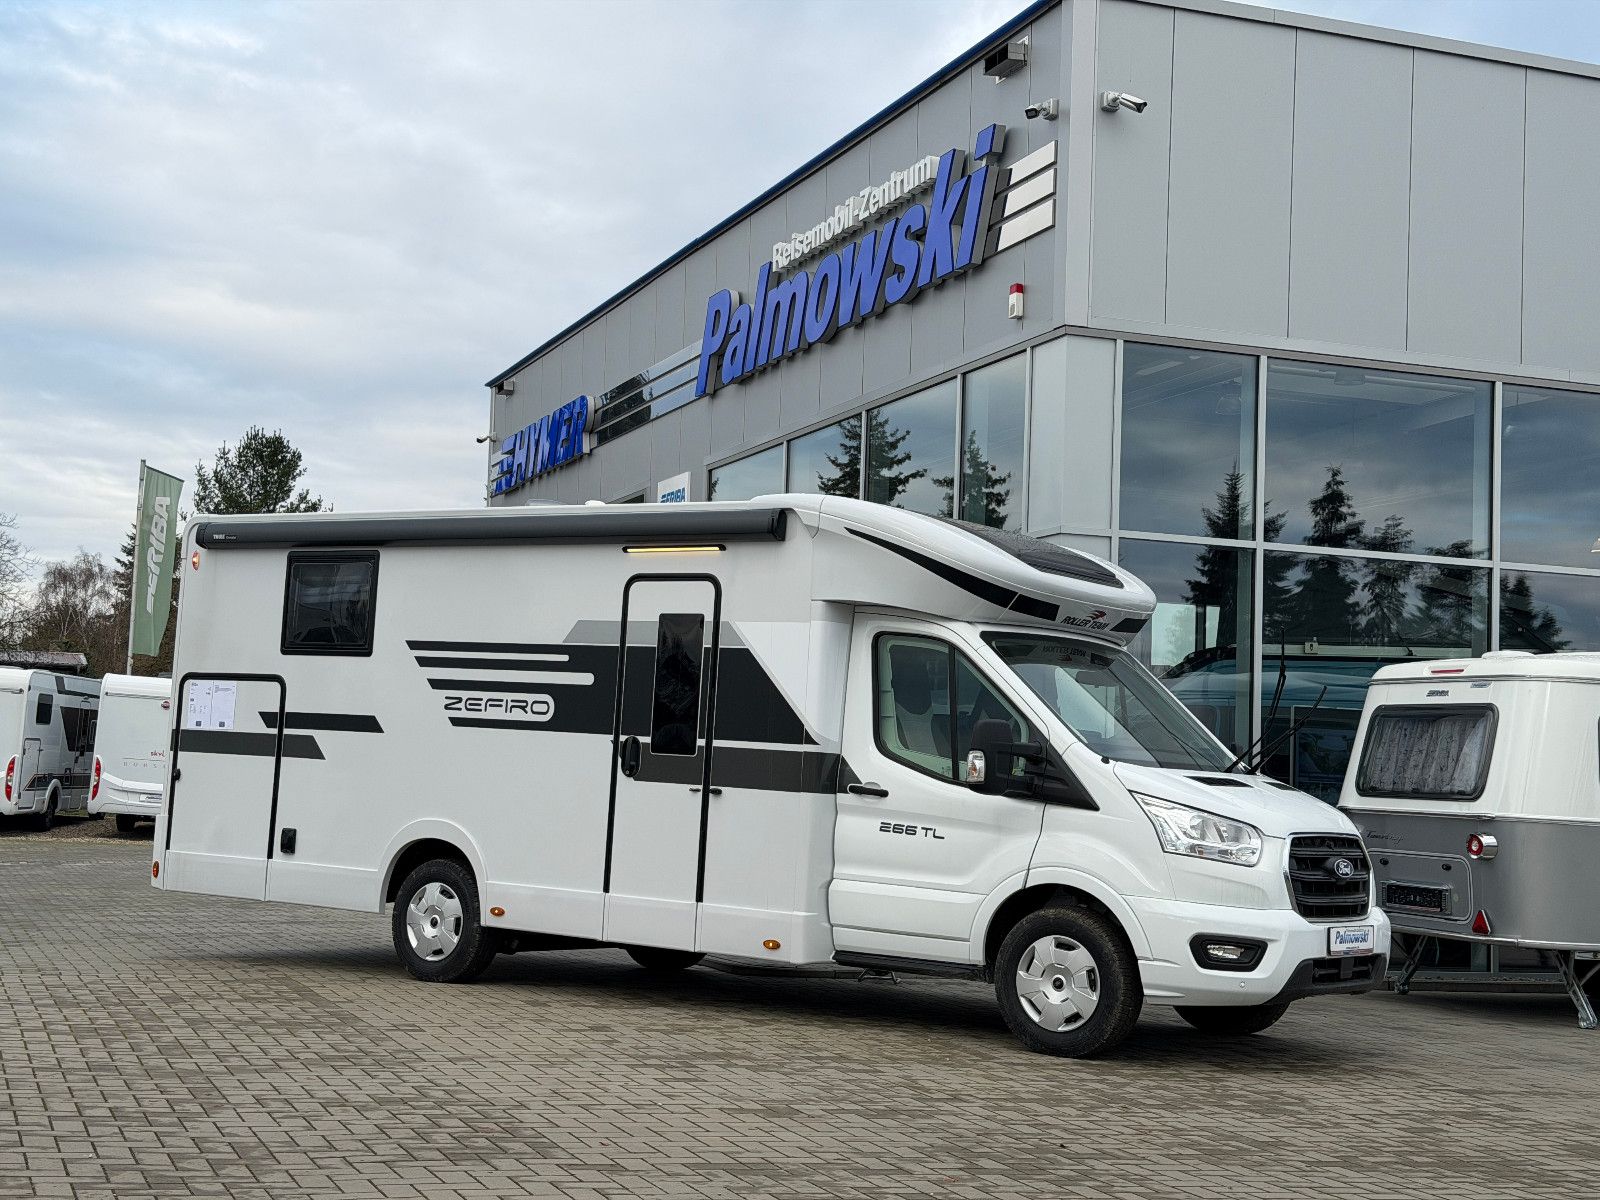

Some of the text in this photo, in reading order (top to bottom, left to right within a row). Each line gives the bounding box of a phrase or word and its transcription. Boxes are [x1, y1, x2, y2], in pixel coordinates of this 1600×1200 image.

[772, 156, 940, 272] Reisemobil-Zentrum
[695, 123, 1000, 398] Palmowski
[506, 395, 590, 488] HYMER
[1060, 615, 1110, 631] ROLLER TEAM
[444, 695, 550, 716] ZEFIRO
[879, 821, 945, 840] 266 TL
[1334, 929, 1370, 945] Palmowski
